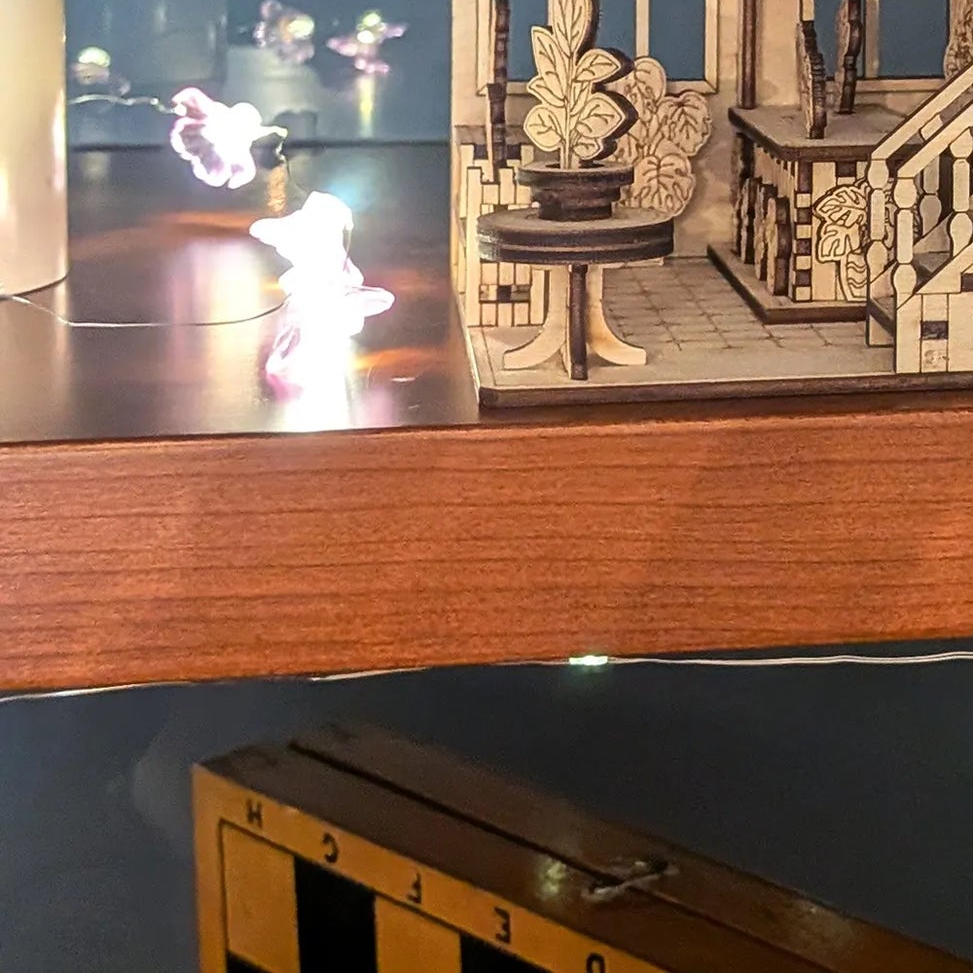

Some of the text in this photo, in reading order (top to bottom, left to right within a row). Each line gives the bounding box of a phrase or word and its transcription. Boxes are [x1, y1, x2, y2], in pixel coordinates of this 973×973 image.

[247, 799, 262, 828] H
[408, 872, 422, 904] F
[494, 907, 511, 944] E
